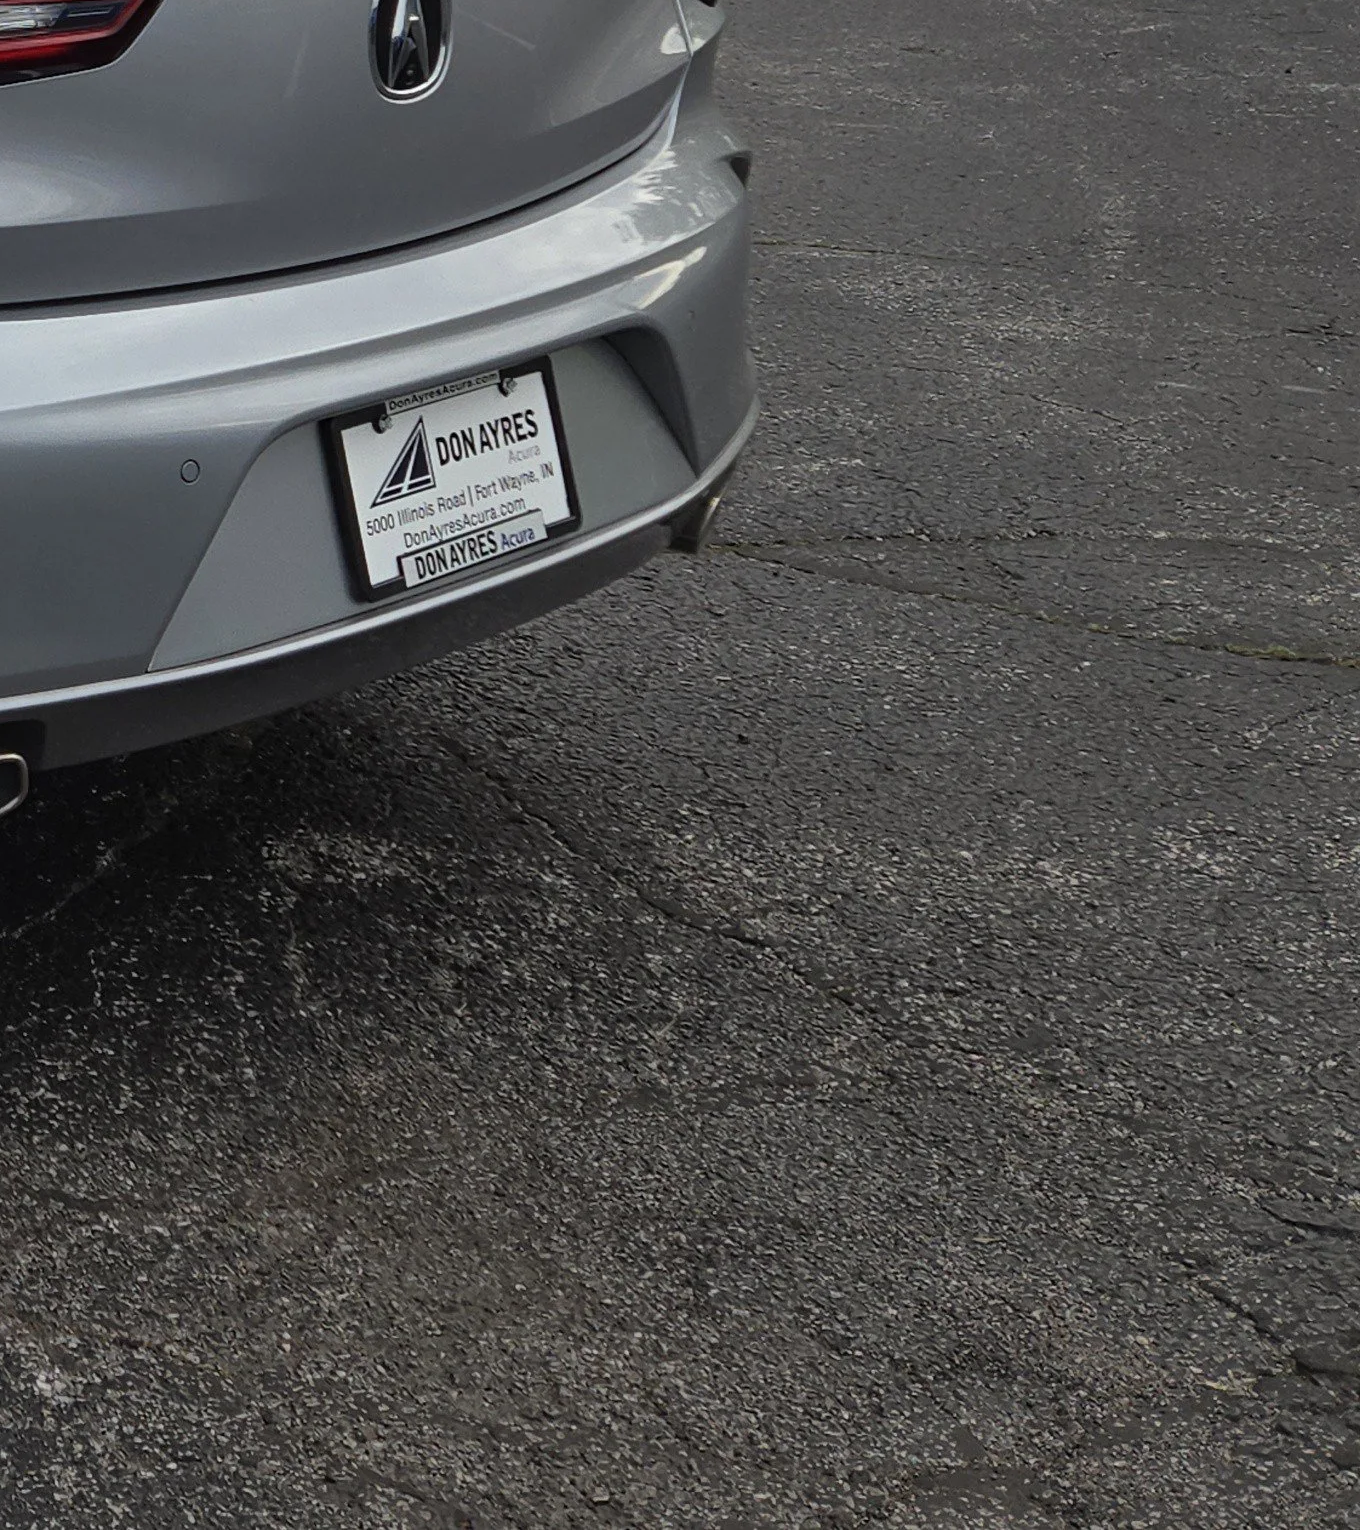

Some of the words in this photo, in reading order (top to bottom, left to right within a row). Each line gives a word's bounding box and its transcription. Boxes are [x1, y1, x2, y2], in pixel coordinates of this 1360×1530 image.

[388, 372, 498, 411] DonAyresAcura.com
[435, 427, 478, 466] DON
[480, 408, 539, 454] AYRES
[507, 444, 541, 464] Acura
[366, 512, 395, 536] 5000
[397, 502, 435, 526] Illinois
[438, 489, 466, 513] Road
[475, 481, 498, 501] Fort
[540, 461, 555, 479] IN
[403, 497, 527, 549] DonAyresAcura.com
[414, 546, 449, 580] DON
[450, 530, 499, 569] AYRES
[500, 527, 536, 551] Acura
